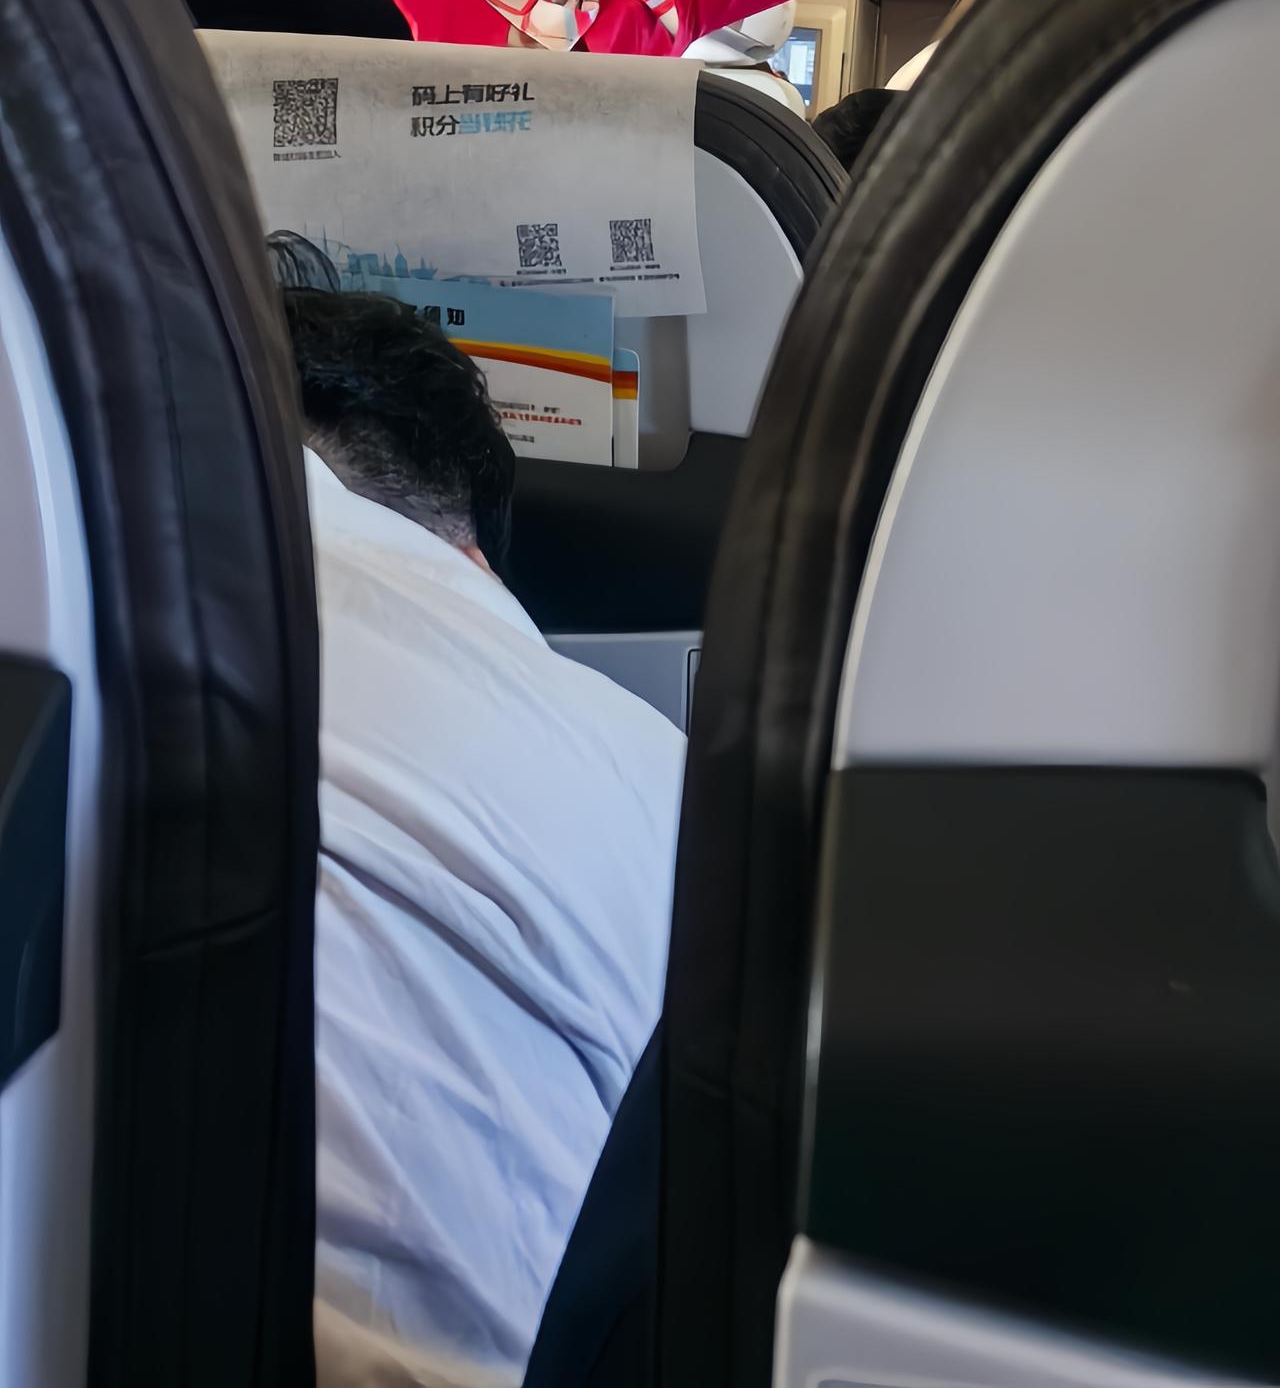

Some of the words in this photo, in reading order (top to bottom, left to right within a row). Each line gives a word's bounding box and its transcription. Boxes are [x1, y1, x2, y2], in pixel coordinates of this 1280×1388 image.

[412, 82, 535, 106] 码上有好礼
